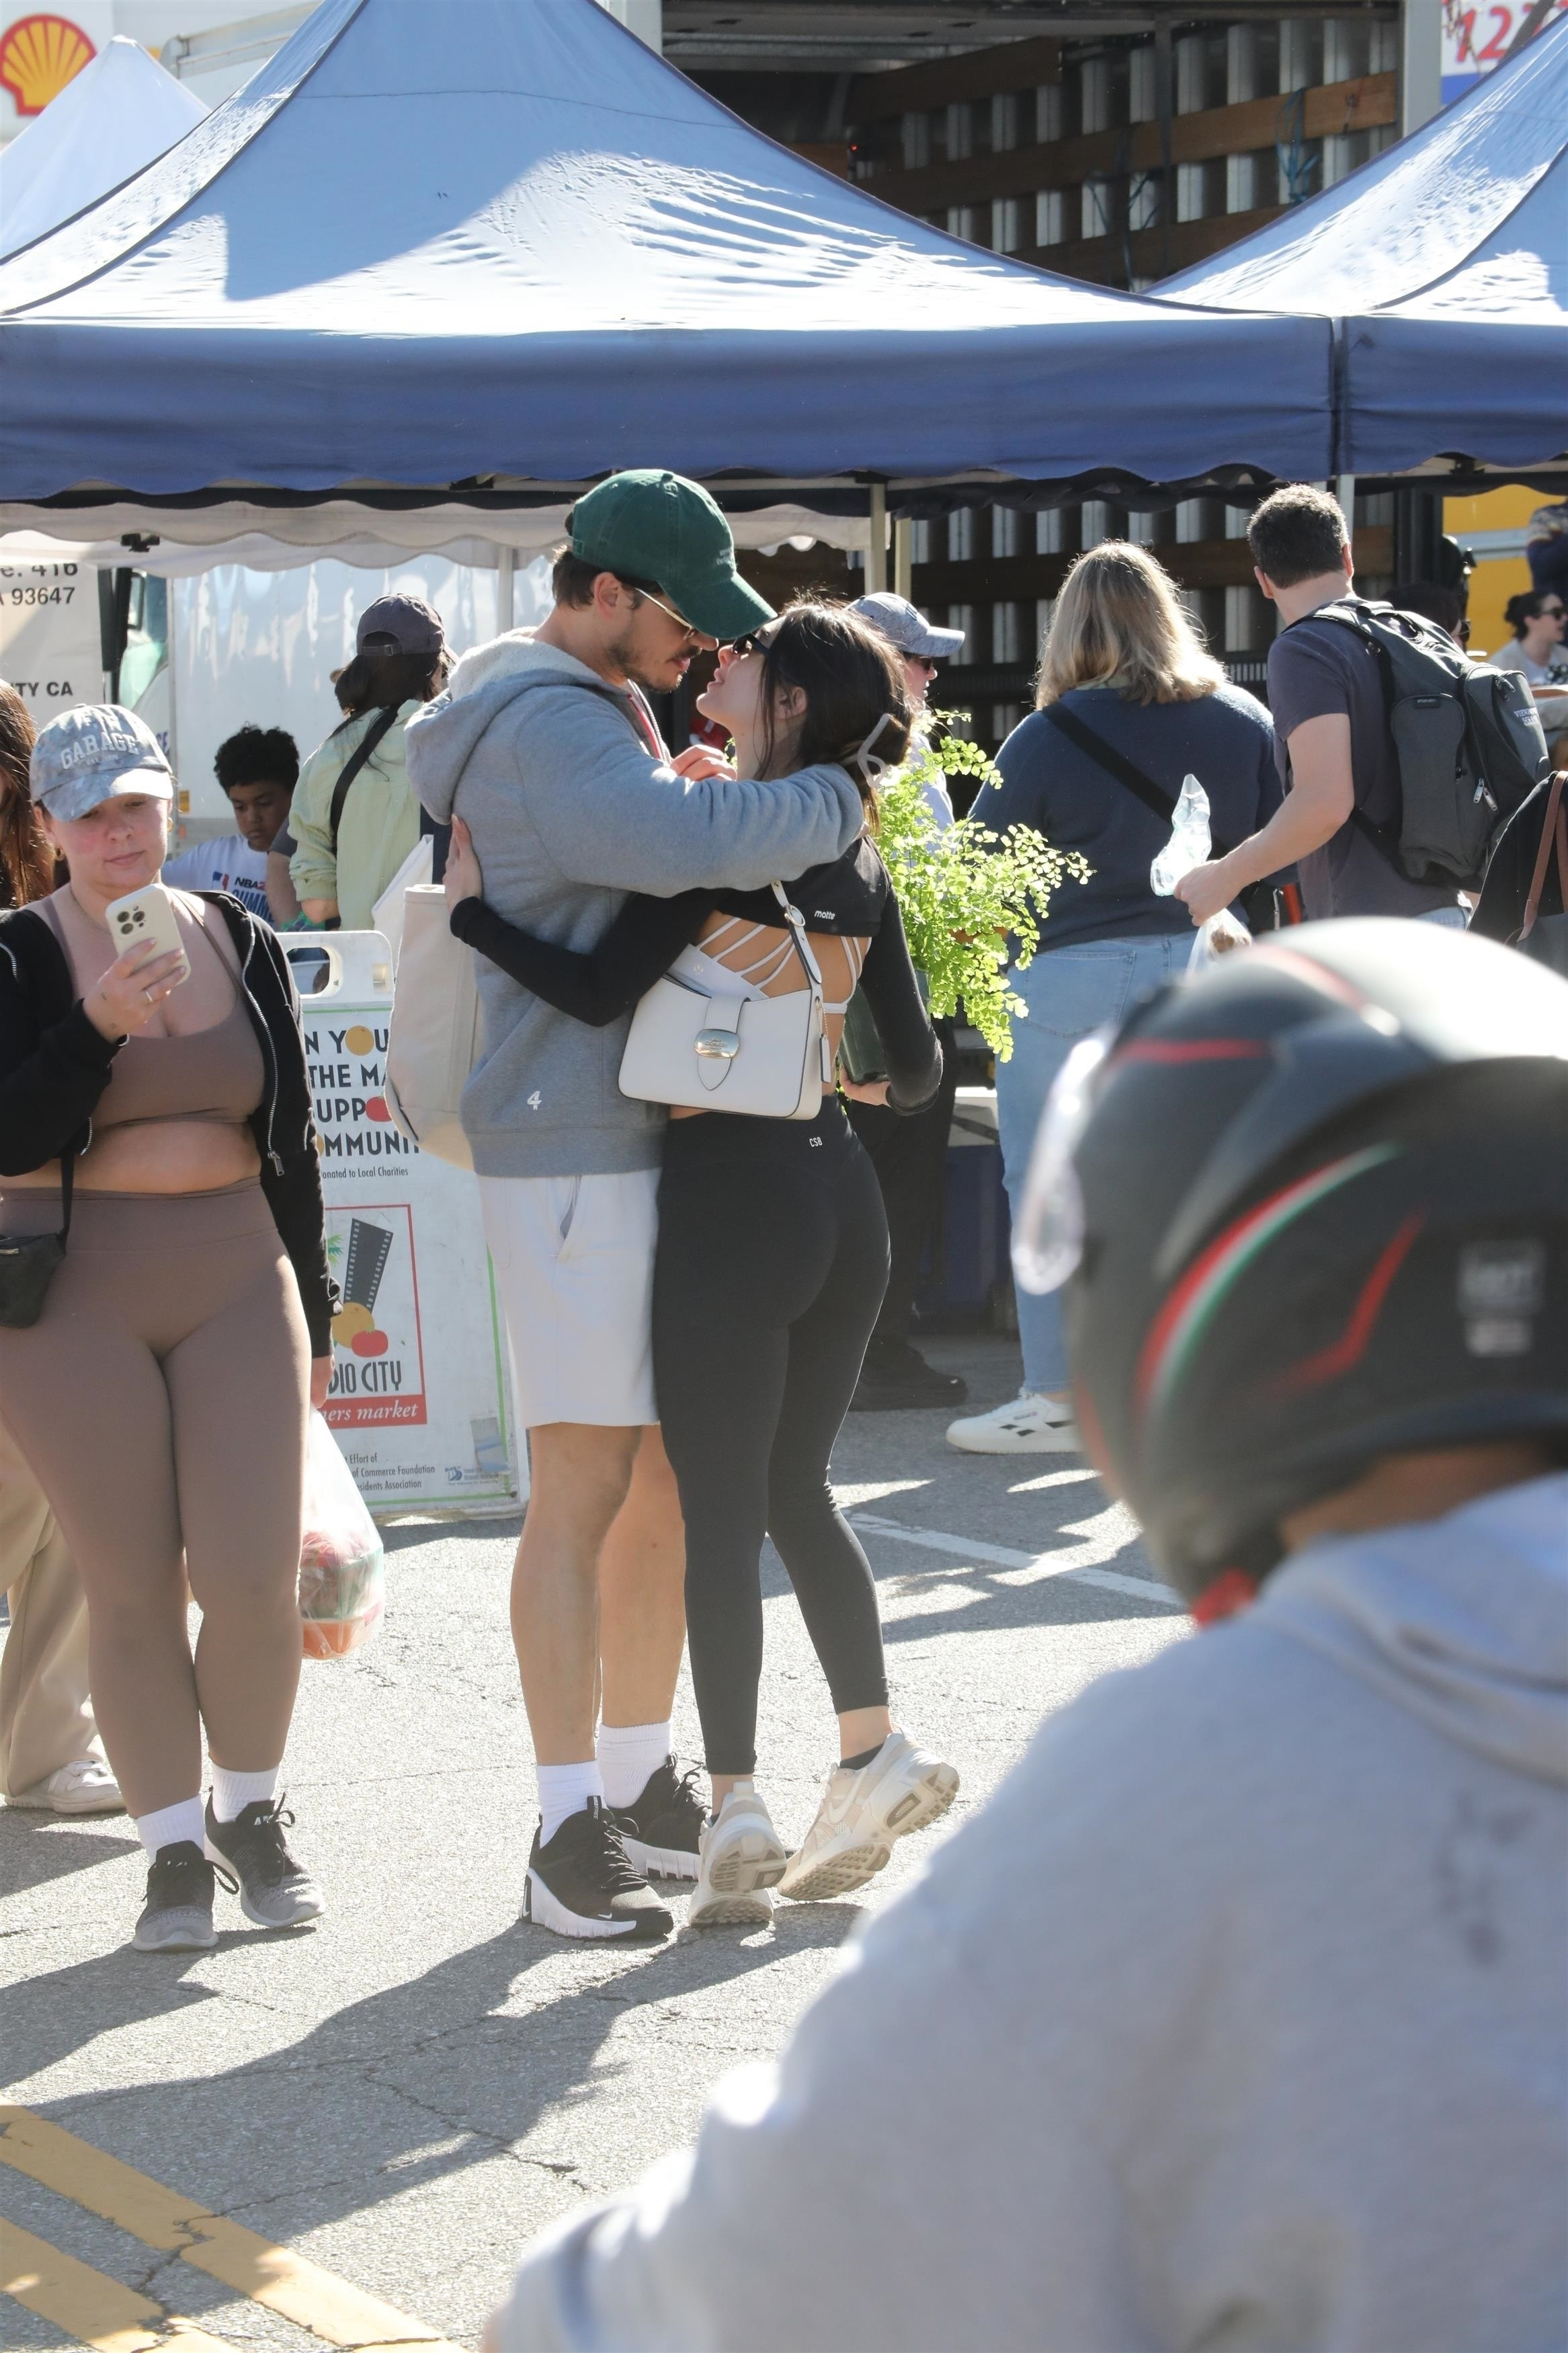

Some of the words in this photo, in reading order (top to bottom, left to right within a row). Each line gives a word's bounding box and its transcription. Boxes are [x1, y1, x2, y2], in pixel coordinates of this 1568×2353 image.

[11, 587, 75, 605] 93647
[11, 682, 39, 697] TY
[46, 682, 73, 696] CA
[60, 732, 140, 770] GARAGE
[308, 1064, 352, 1089] THE
[360, 1063, 387, 1087] M
[317, 1130, 419, 1157] MMUNI
[809, 1137, 823, 1148] CSB
[321, 1168, 347, 1179] onated
[349, 1168, 356, 1178] to
[358, 1167, 376, 1178] Local
[378, 1166, 409, 1176] Charities
[361, 1360, 402, 1392] CITY
[356, 1400, 419, 1421] market
[349, 1453, 369, 1464] Effort
[370, 1452, 378, 1464] of
[352, 1468, 360, 1478] of
[361, 1466, 396, 1478] Commerce
[397, 1464, 436, 1476] Foundation
[384, 1479, 422, 1490] Association
